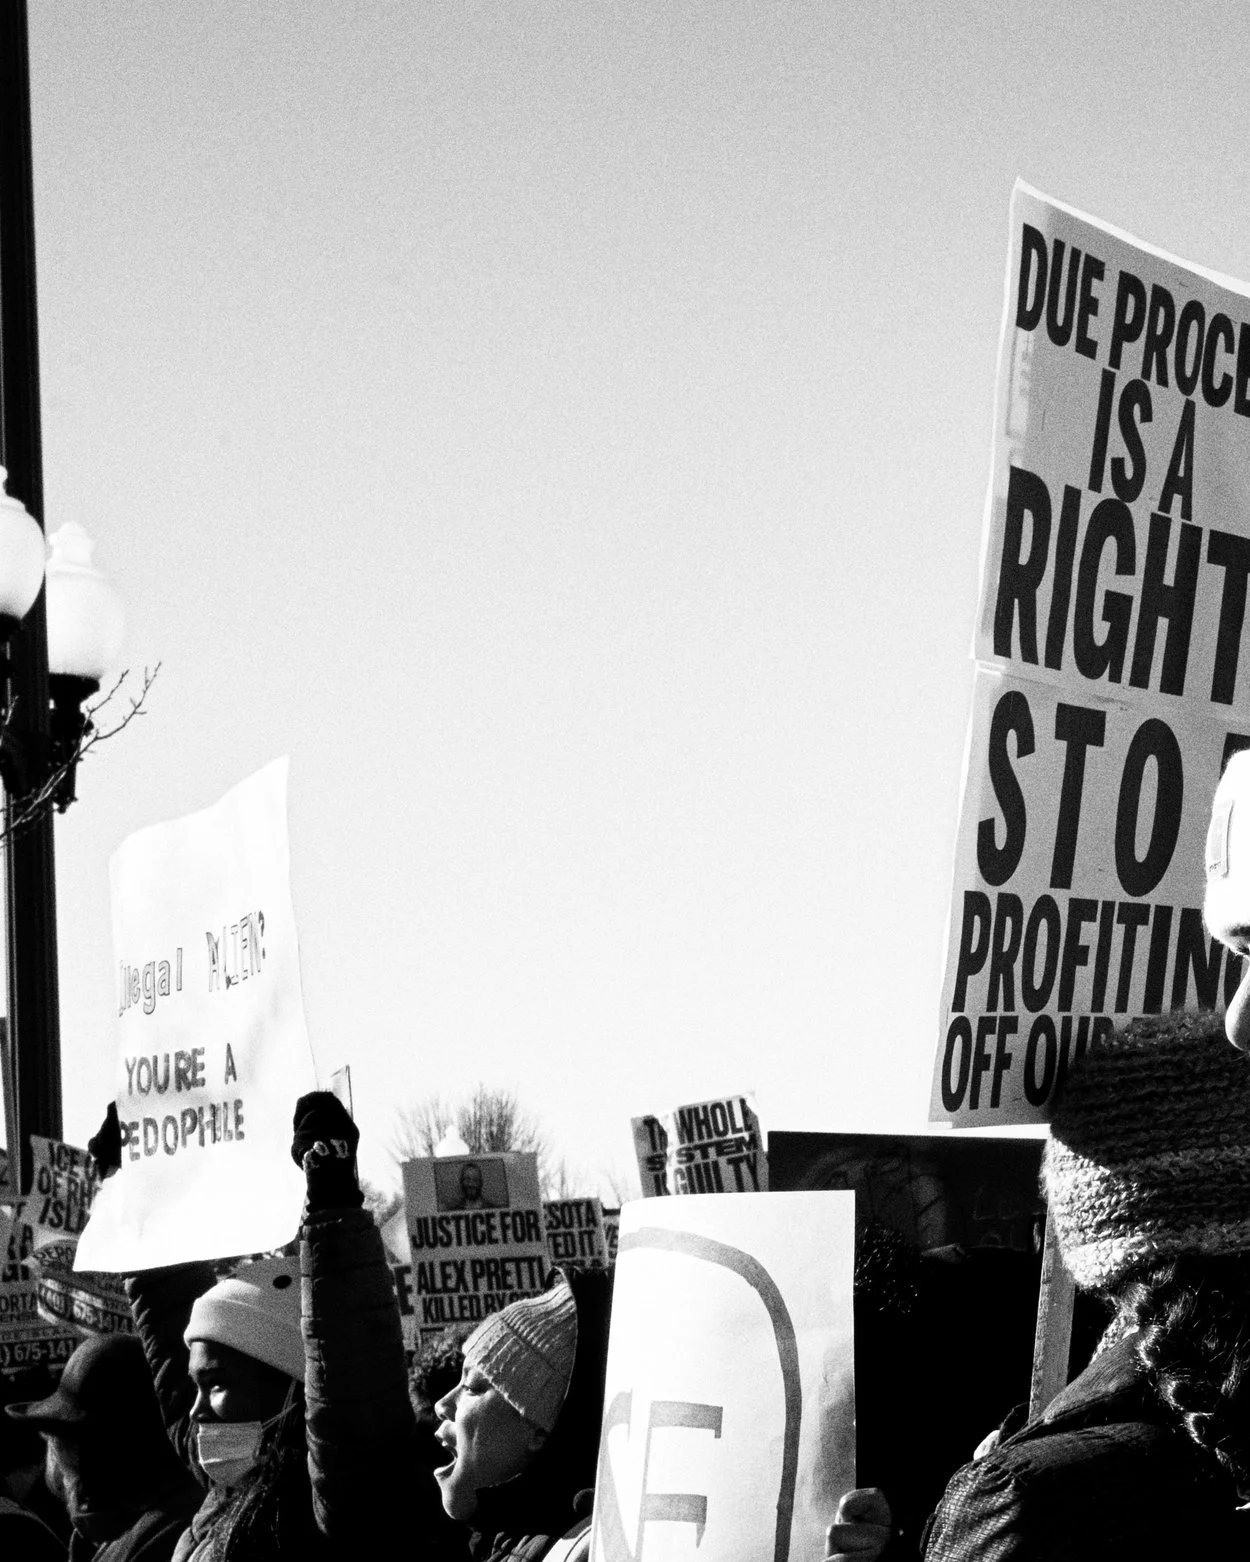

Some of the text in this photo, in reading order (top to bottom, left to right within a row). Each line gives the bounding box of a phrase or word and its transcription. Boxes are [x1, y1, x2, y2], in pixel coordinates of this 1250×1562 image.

[1016, 222, 1105, 361] DUE
[1088, 367, 1197, 522] IS A
[225, 1043, 237, 1085] A
[941, 1014, 1018, 1113] OFF
[412, 1209, 542, 1250] JUSTICE FOR
[417, 1258, 469, 1295] ALEX
[471, 1255, 546, 1292] PRETTI
[421, 1294, 481, 1323] KILLED
